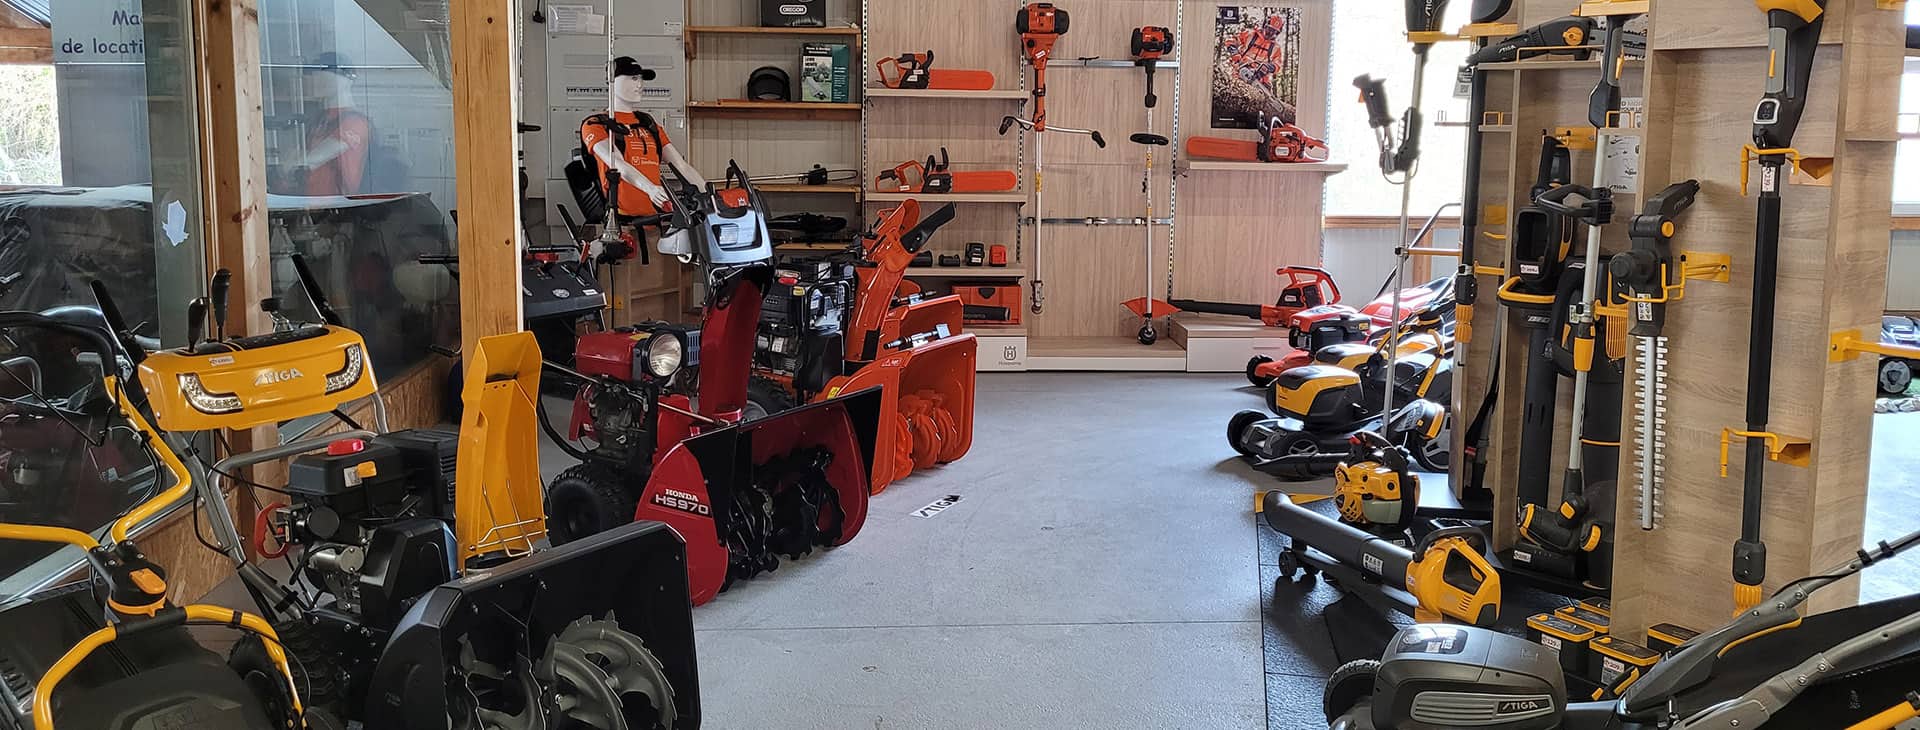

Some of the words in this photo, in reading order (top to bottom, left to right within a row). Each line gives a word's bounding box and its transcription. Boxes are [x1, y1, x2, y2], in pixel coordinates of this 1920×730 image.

[62, 38, 84, 54] de
[93, 38, 143, 54] locati
[255, 368, 304, 387] STIGA
[665, 488, 699, 502] HONDA
[655, 494, 709, 515] HS970
[1502, 701, 1538, 711] STIGA
